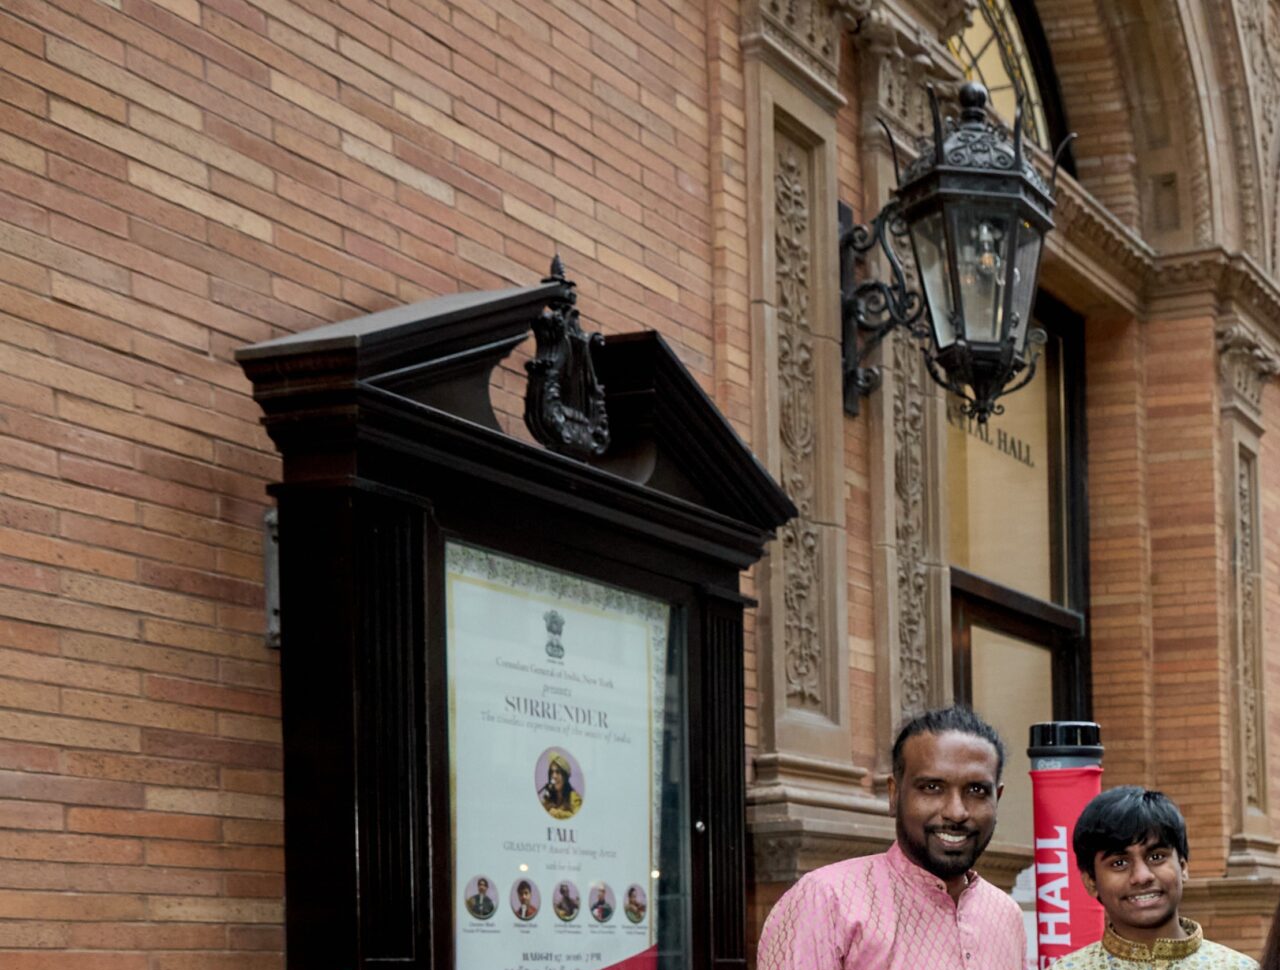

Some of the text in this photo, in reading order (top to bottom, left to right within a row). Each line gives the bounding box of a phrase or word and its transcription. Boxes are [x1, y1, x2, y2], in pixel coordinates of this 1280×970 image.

[997, 428, 1035, 468] HALL
[505, 695, 609, 729] SURRENDER
[546, 826, 577, 843] FALU
[1036, 825, 1071, 946] HALL
[522, 952, 553, 961] MARCH
